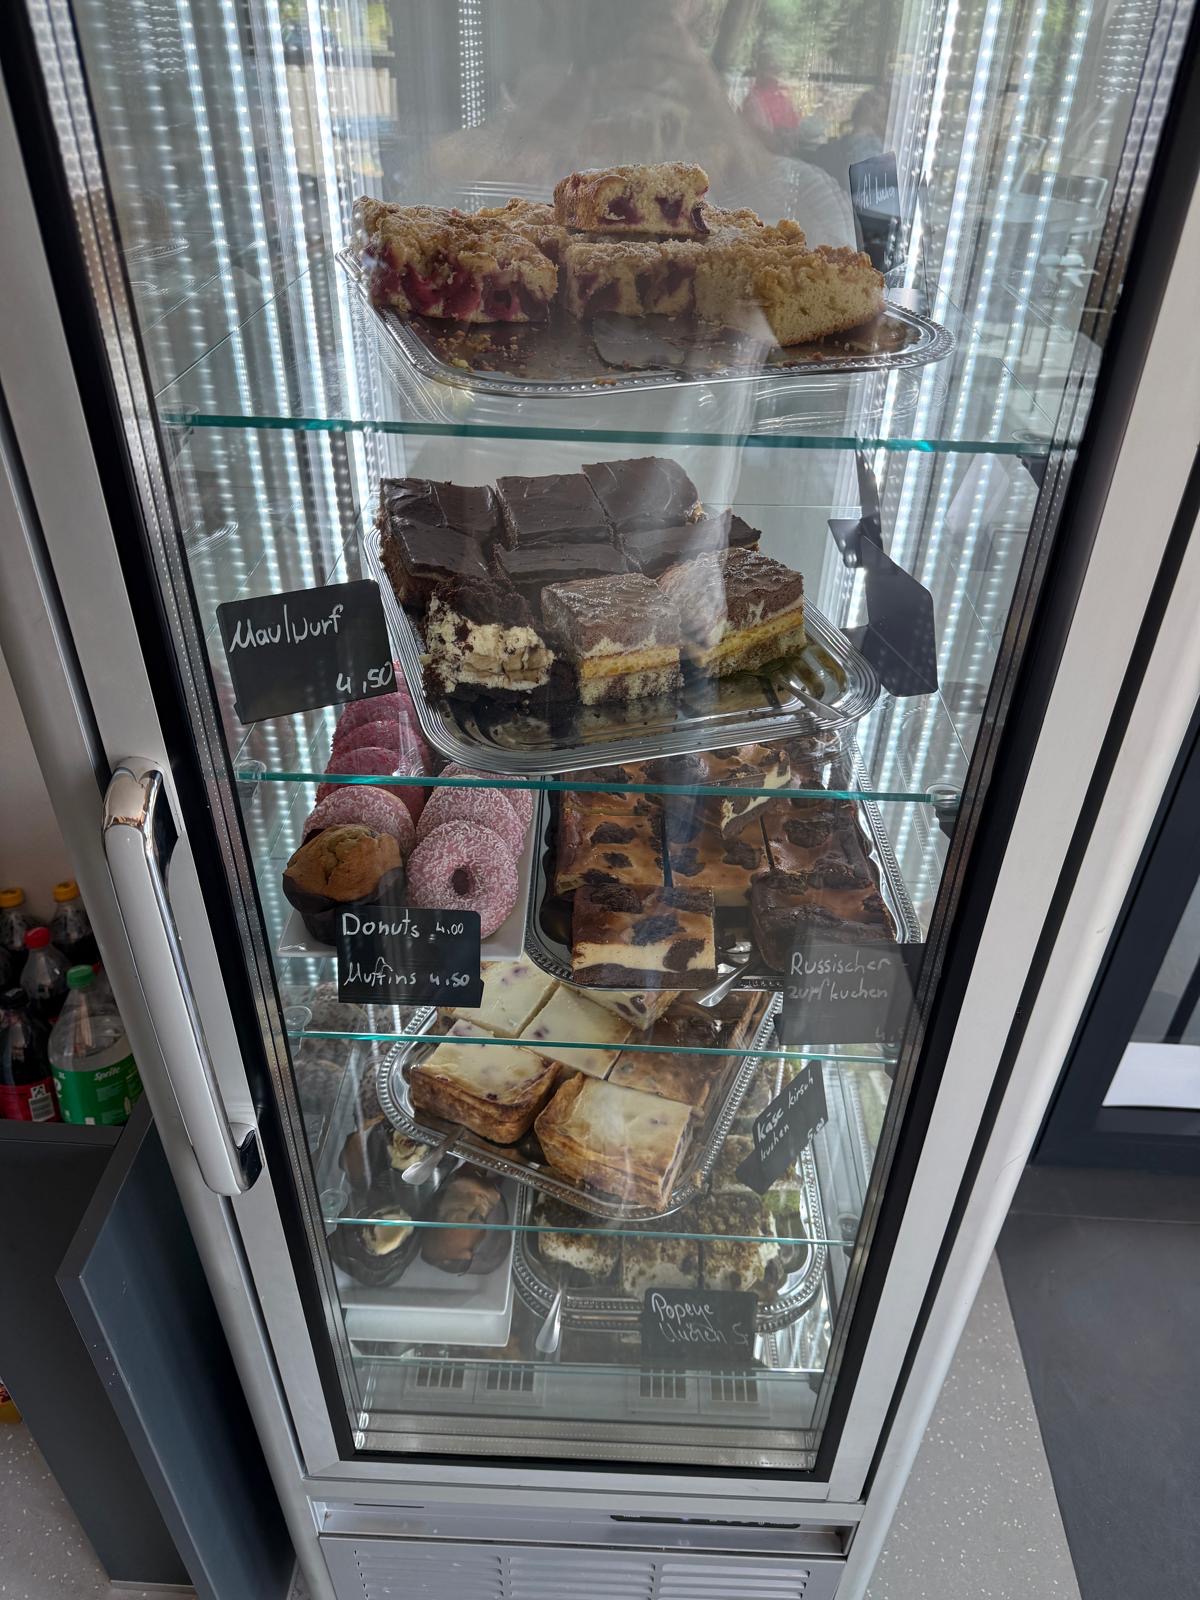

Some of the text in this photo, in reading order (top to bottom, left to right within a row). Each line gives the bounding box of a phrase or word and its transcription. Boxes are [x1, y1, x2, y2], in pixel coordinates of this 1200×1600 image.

[229, 603, 344, 653] Maulwurf
[342, 909, 420, 938] Donuts
[343, 956, 417, 987] Muffins
[790, 950, 891, 975] Russischer
[651, 1292, 714, 1332] Popeye
